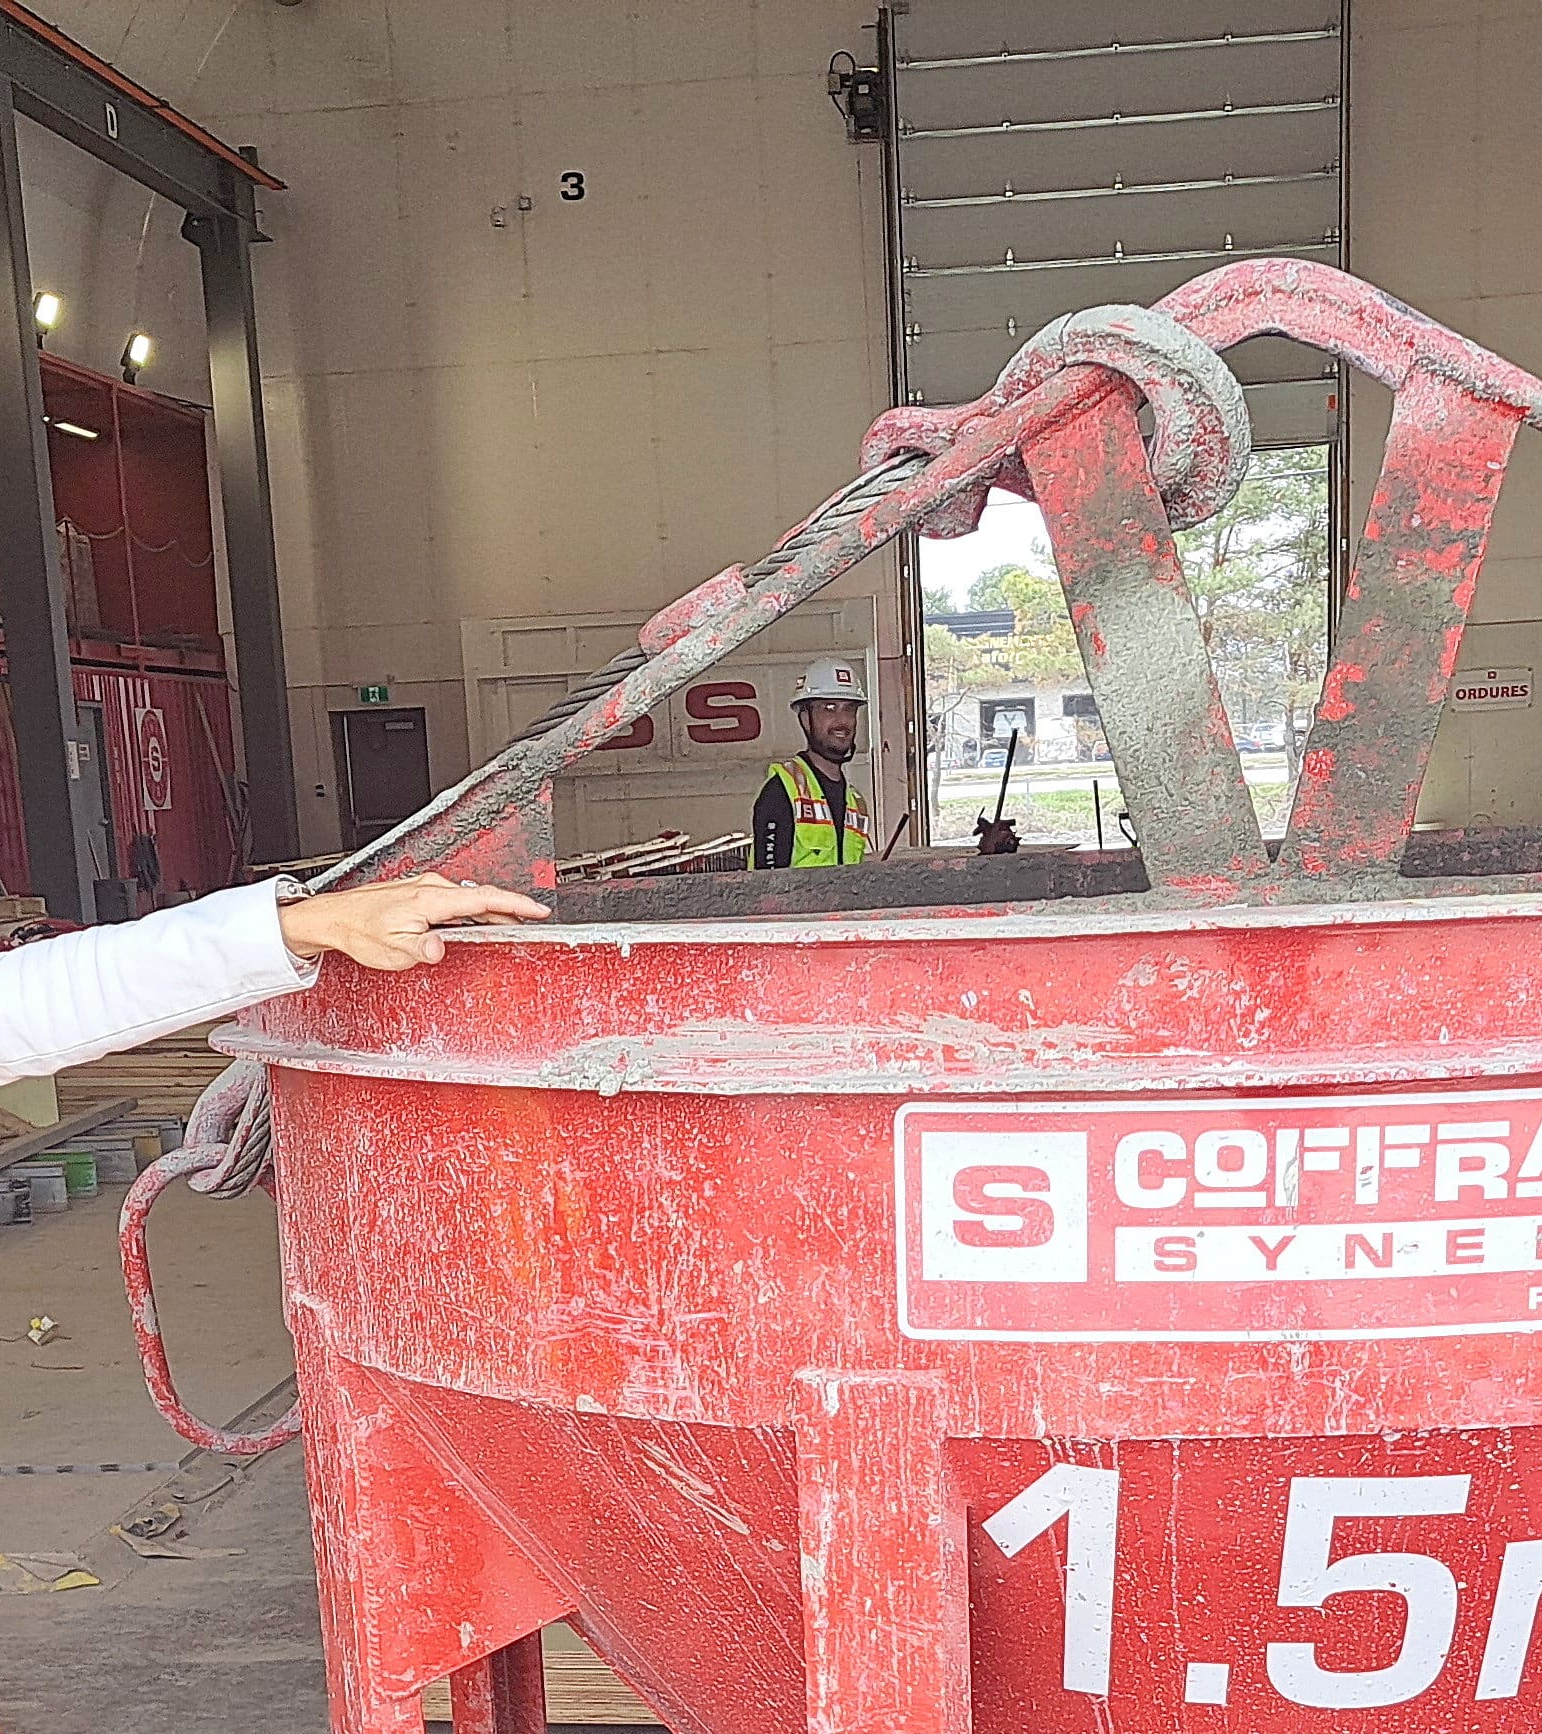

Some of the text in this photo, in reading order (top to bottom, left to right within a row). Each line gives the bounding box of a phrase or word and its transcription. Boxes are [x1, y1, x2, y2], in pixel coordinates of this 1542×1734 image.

[105, 102, 118, 139] D
[560, 171, 585, 200] 3
[1455, 684, 1529, 701] ORDURES
[685, 681, 762, 744] S
[951, 1164, 1056, 1249] S
